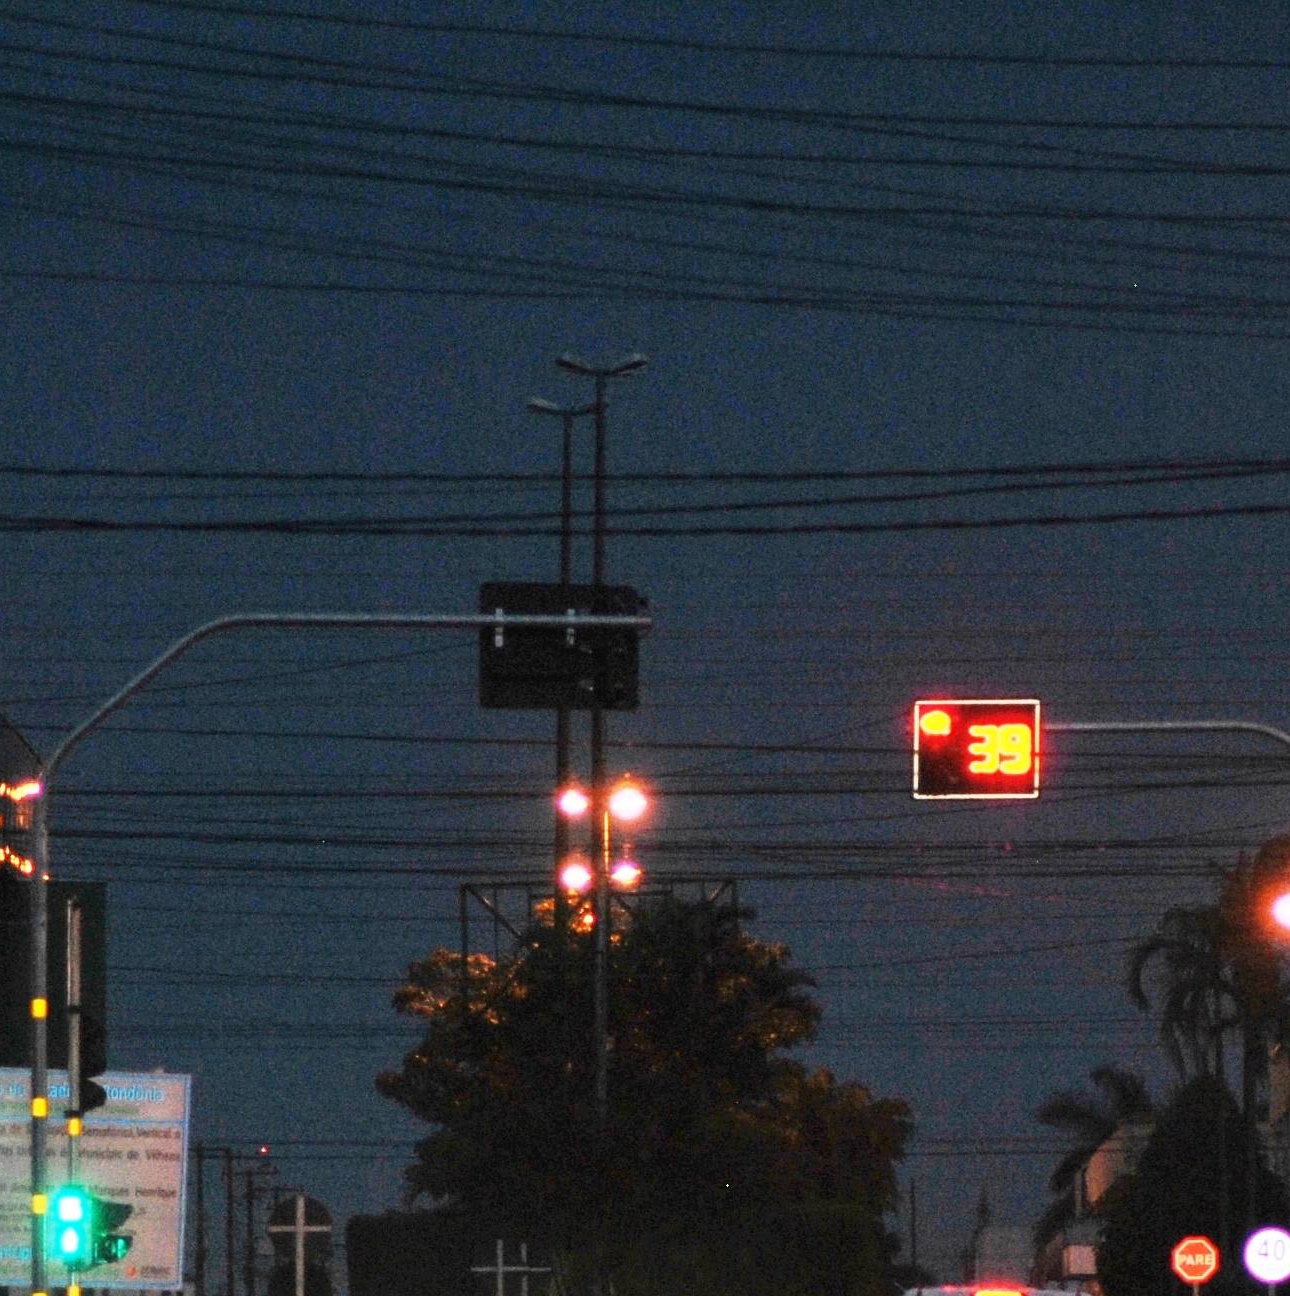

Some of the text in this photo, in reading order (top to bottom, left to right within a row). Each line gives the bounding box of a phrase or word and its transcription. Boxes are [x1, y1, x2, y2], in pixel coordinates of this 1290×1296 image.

[969, 724, 1032, 775] 39
[1177, 1254, 1213, 1266] PARE
[1258, 1239, 1285, 1261] 40
